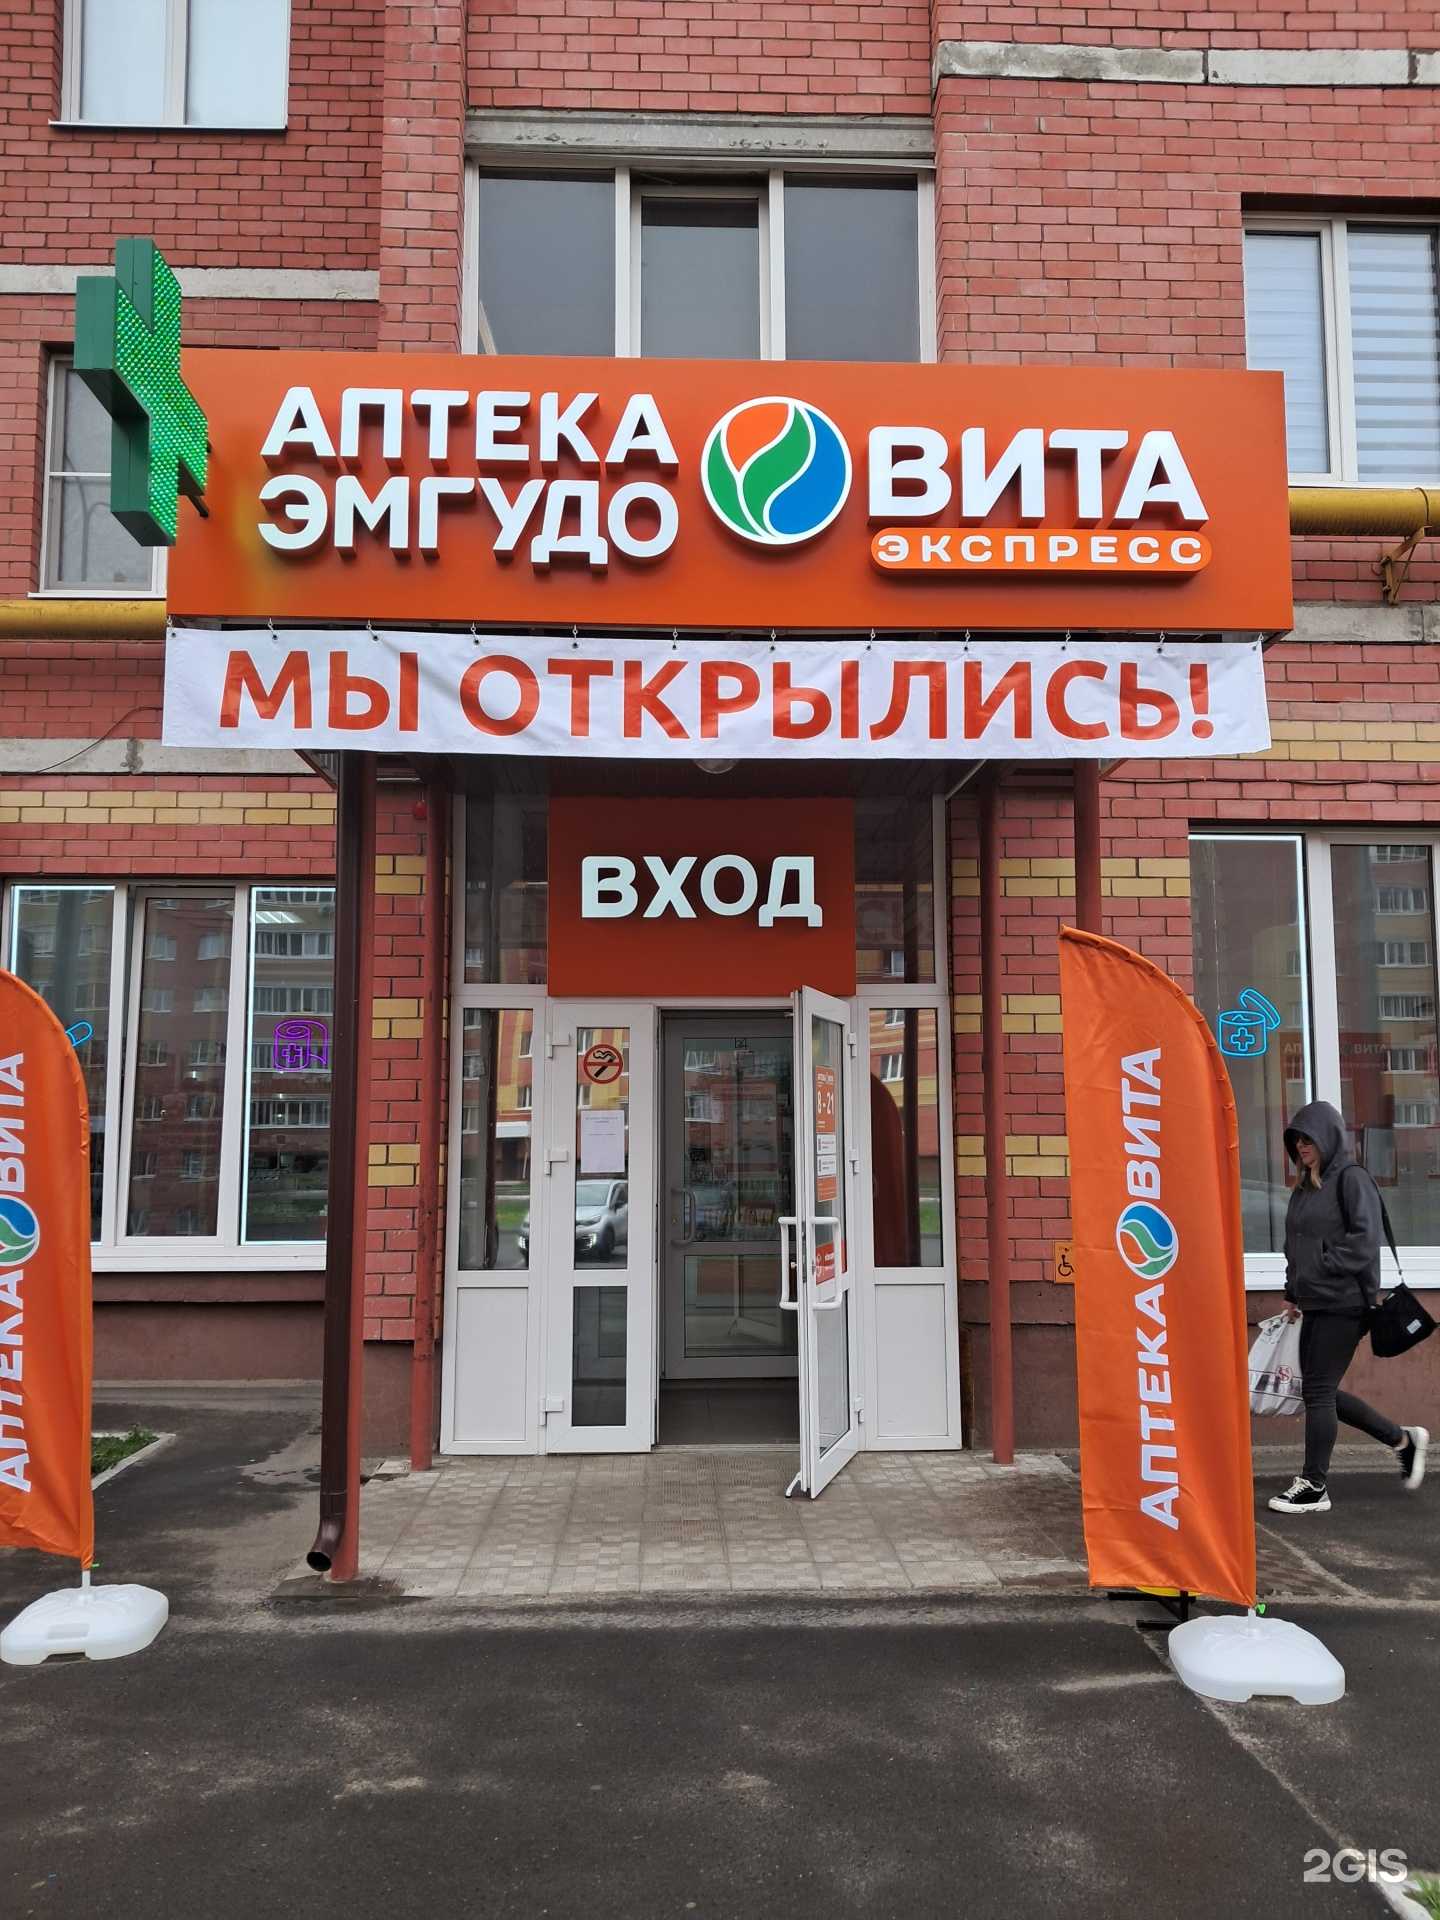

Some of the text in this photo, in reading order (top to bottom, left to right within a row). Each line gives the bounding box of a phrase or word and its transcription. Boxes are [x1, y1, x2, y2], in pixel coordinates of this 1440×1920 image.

[260, 386, 680, 465] АПТЕКА
[867, 425, 1209, 521] ВИТА
[257, 474, 680, 566] ЭМГУДО
[876, 533, 1204, 565] ЭКСПРЕСС
[219, 650, 1216, 742] МЫ ОТКРЫЛИСЬ!
[581, 854, 823, 928] ВХОД
[1120, 1046, 1180, 1532] АПТЕКА ВИТА
